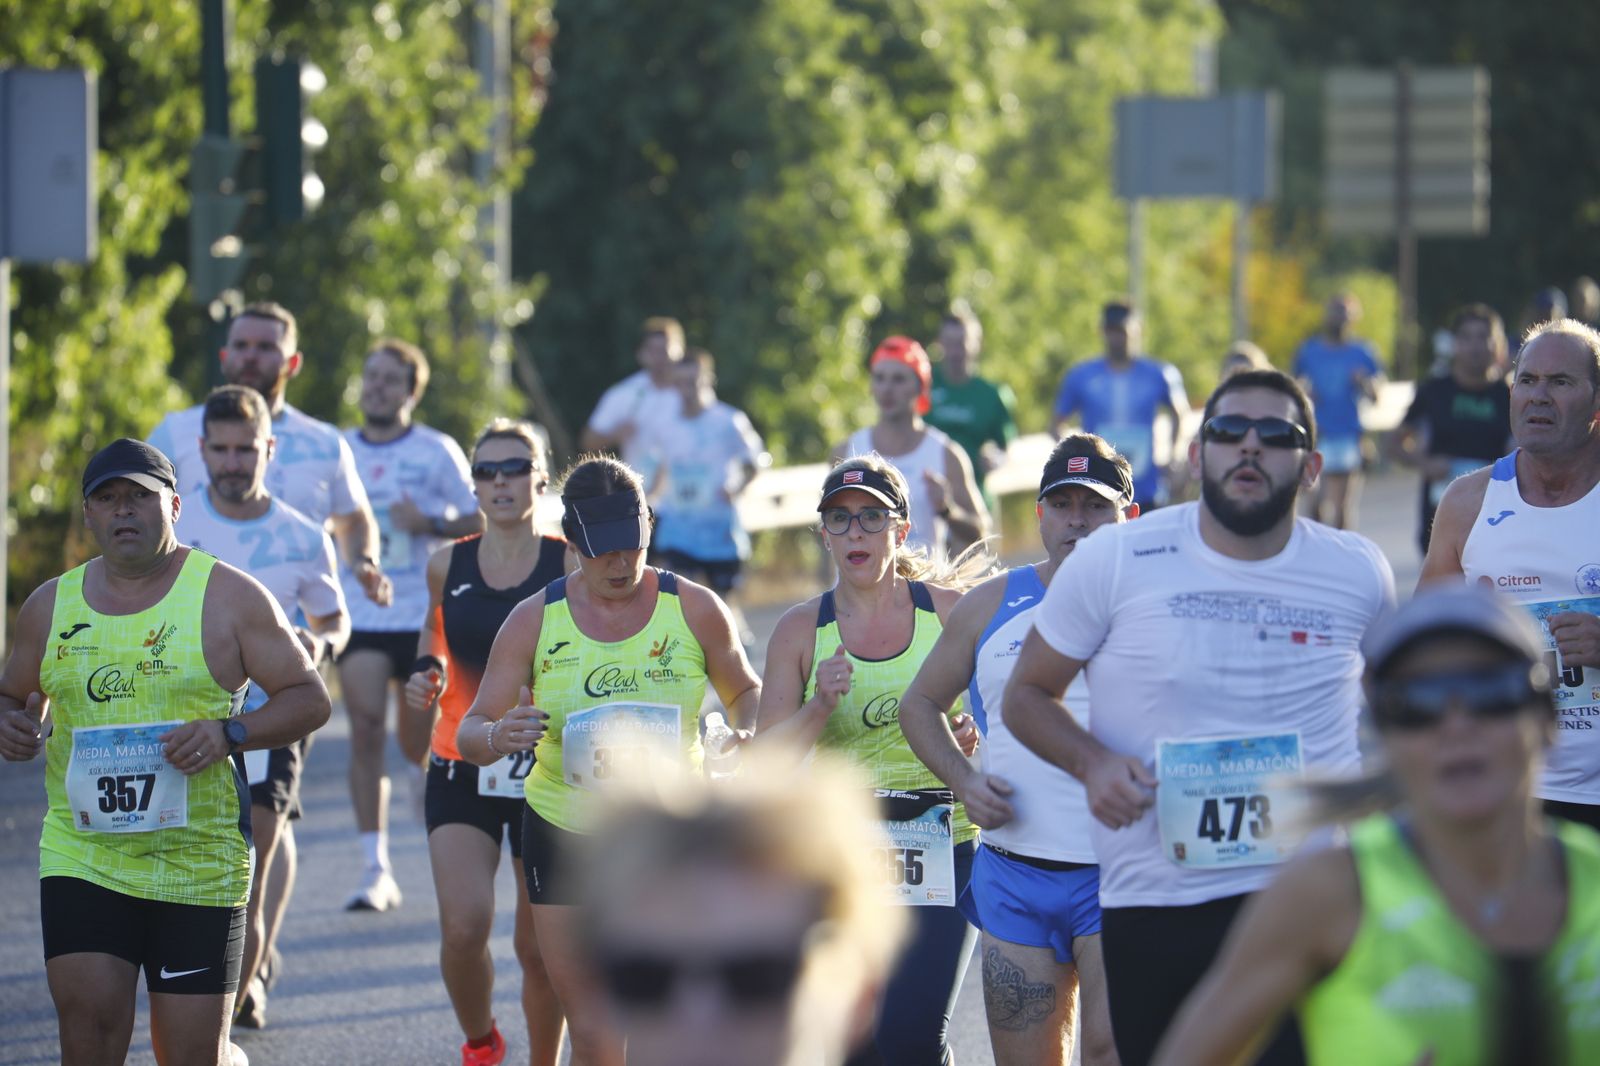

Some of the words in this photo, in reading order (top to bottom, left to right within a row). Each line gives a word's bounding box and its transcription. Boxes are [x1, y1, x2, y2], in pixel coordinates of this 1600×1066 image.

[1497, 575, 1542, 587] Citran
[569, 720, 610, 733] MEDIA
[76, 748, 111, 760] MEDIA
[1165, 762, 1215, 778] MEDIA
[1219, 752, 1298, 775] MARATÓN
[97, 773, 156, 814] 357
[1197, 794, 1273, 843] 473
[888, 820, 949, 836] MARATÓN
